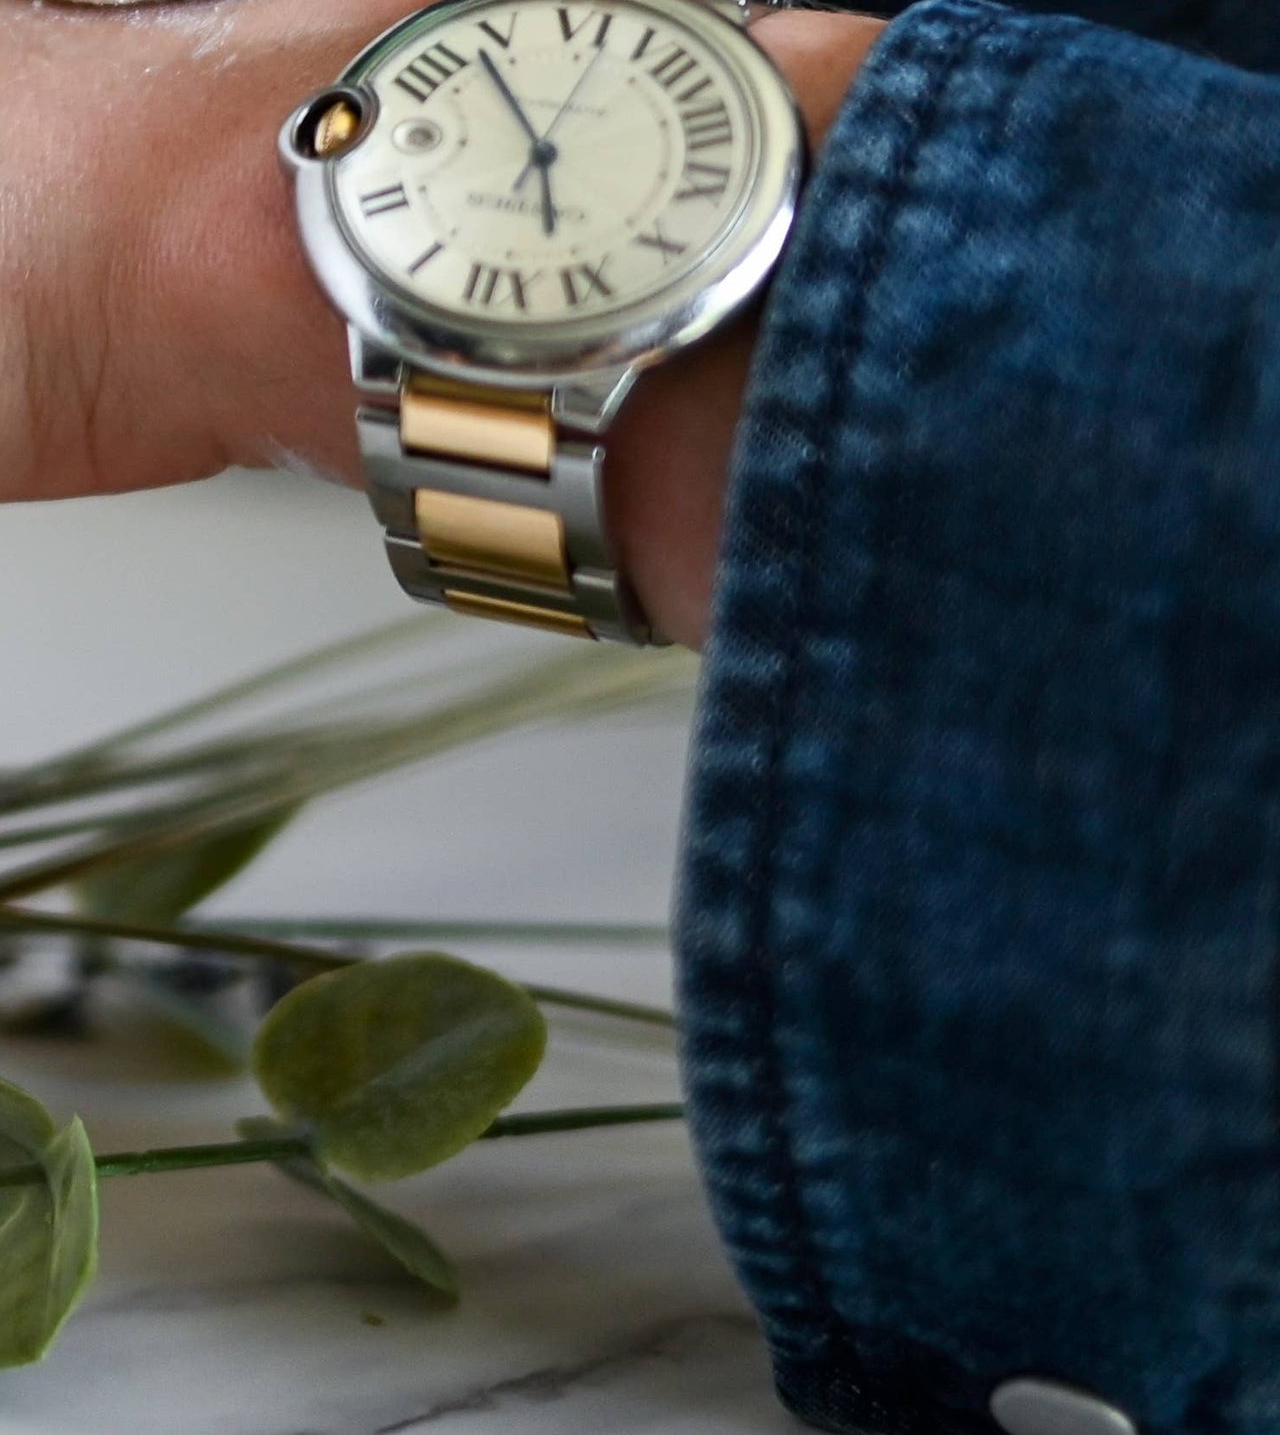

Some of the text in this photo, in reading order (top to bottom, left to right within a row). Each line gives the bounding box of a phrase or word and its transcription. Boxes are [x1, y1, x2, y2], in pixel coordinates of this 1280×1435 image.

[477, 11, 517, 50] V
[557, 8, 613, 48] VI
[360, 183, 410, 218] II
[407, 243, 443, 278] I
[635, 219, 688, 267] X
[461, 263, 542, 309] XII
[559, 254, 611, 308] XI
